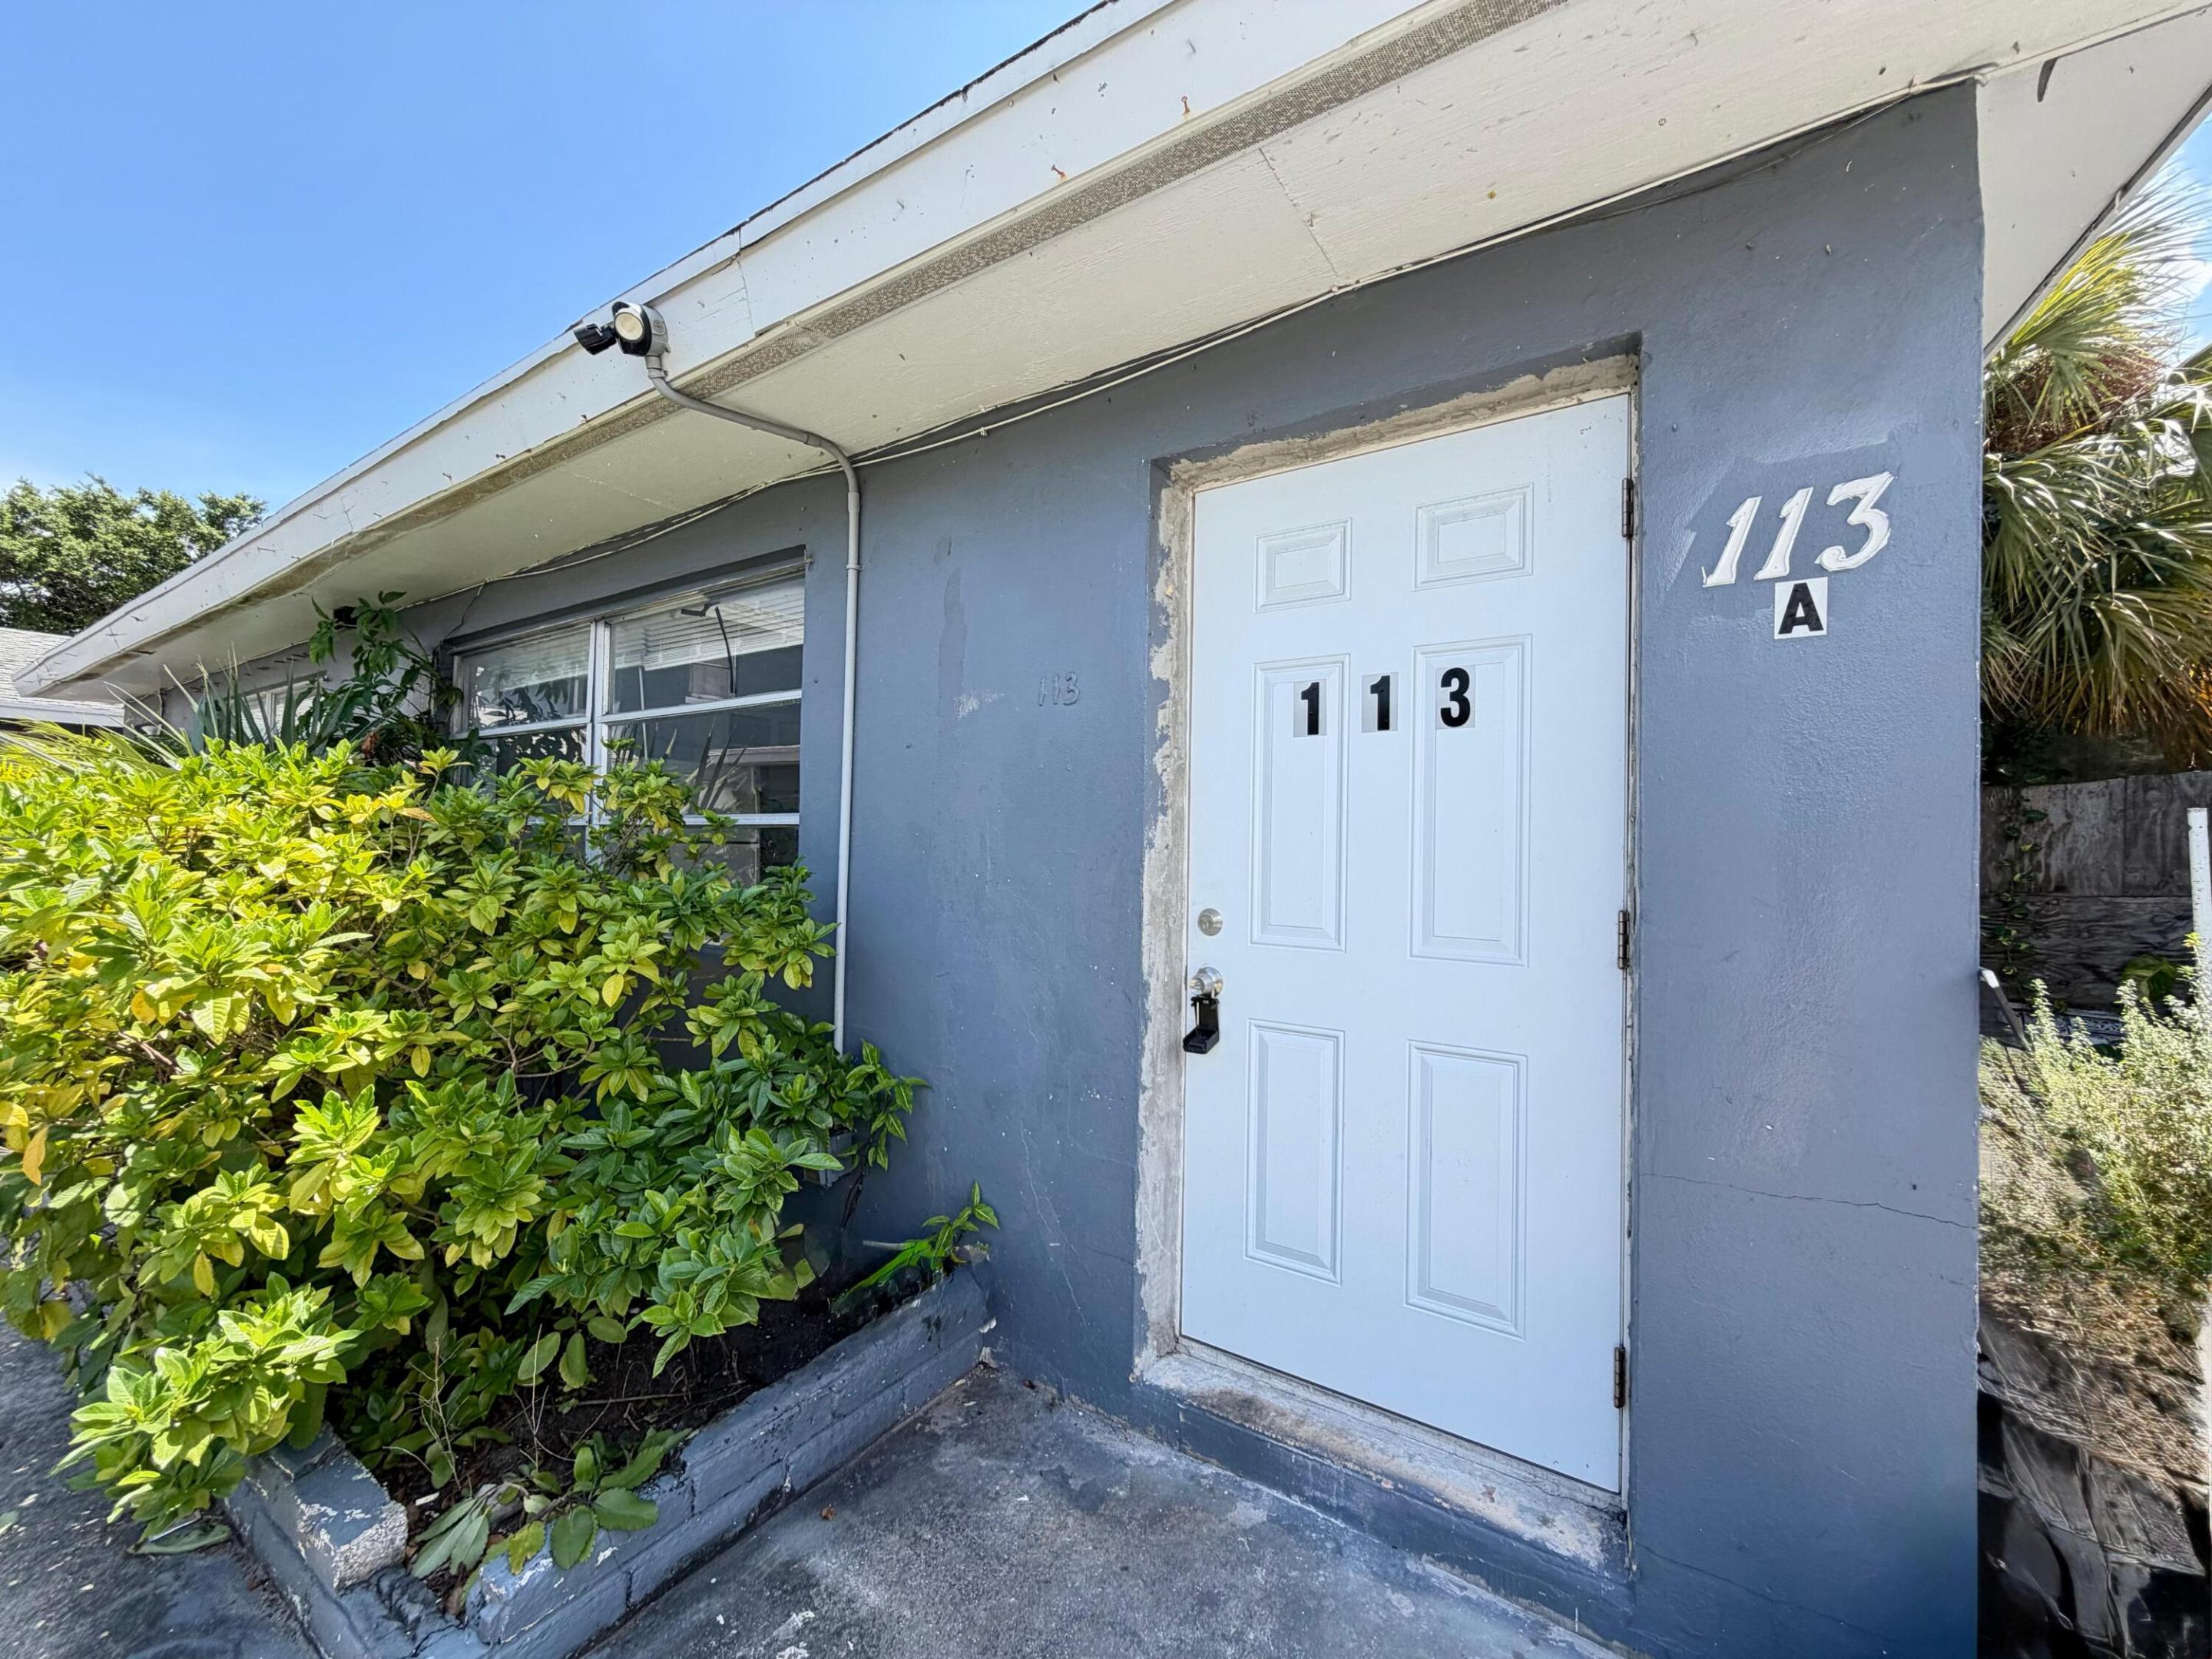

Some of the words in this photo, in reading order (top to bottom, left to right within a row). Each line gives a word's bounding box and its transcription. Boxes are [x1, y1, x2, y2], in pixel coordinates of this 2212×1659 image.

[1702, 471, 1895, 588] 113
[1777, 581, 1825, 635] A
[1038, 671, 1081, 707] 113
